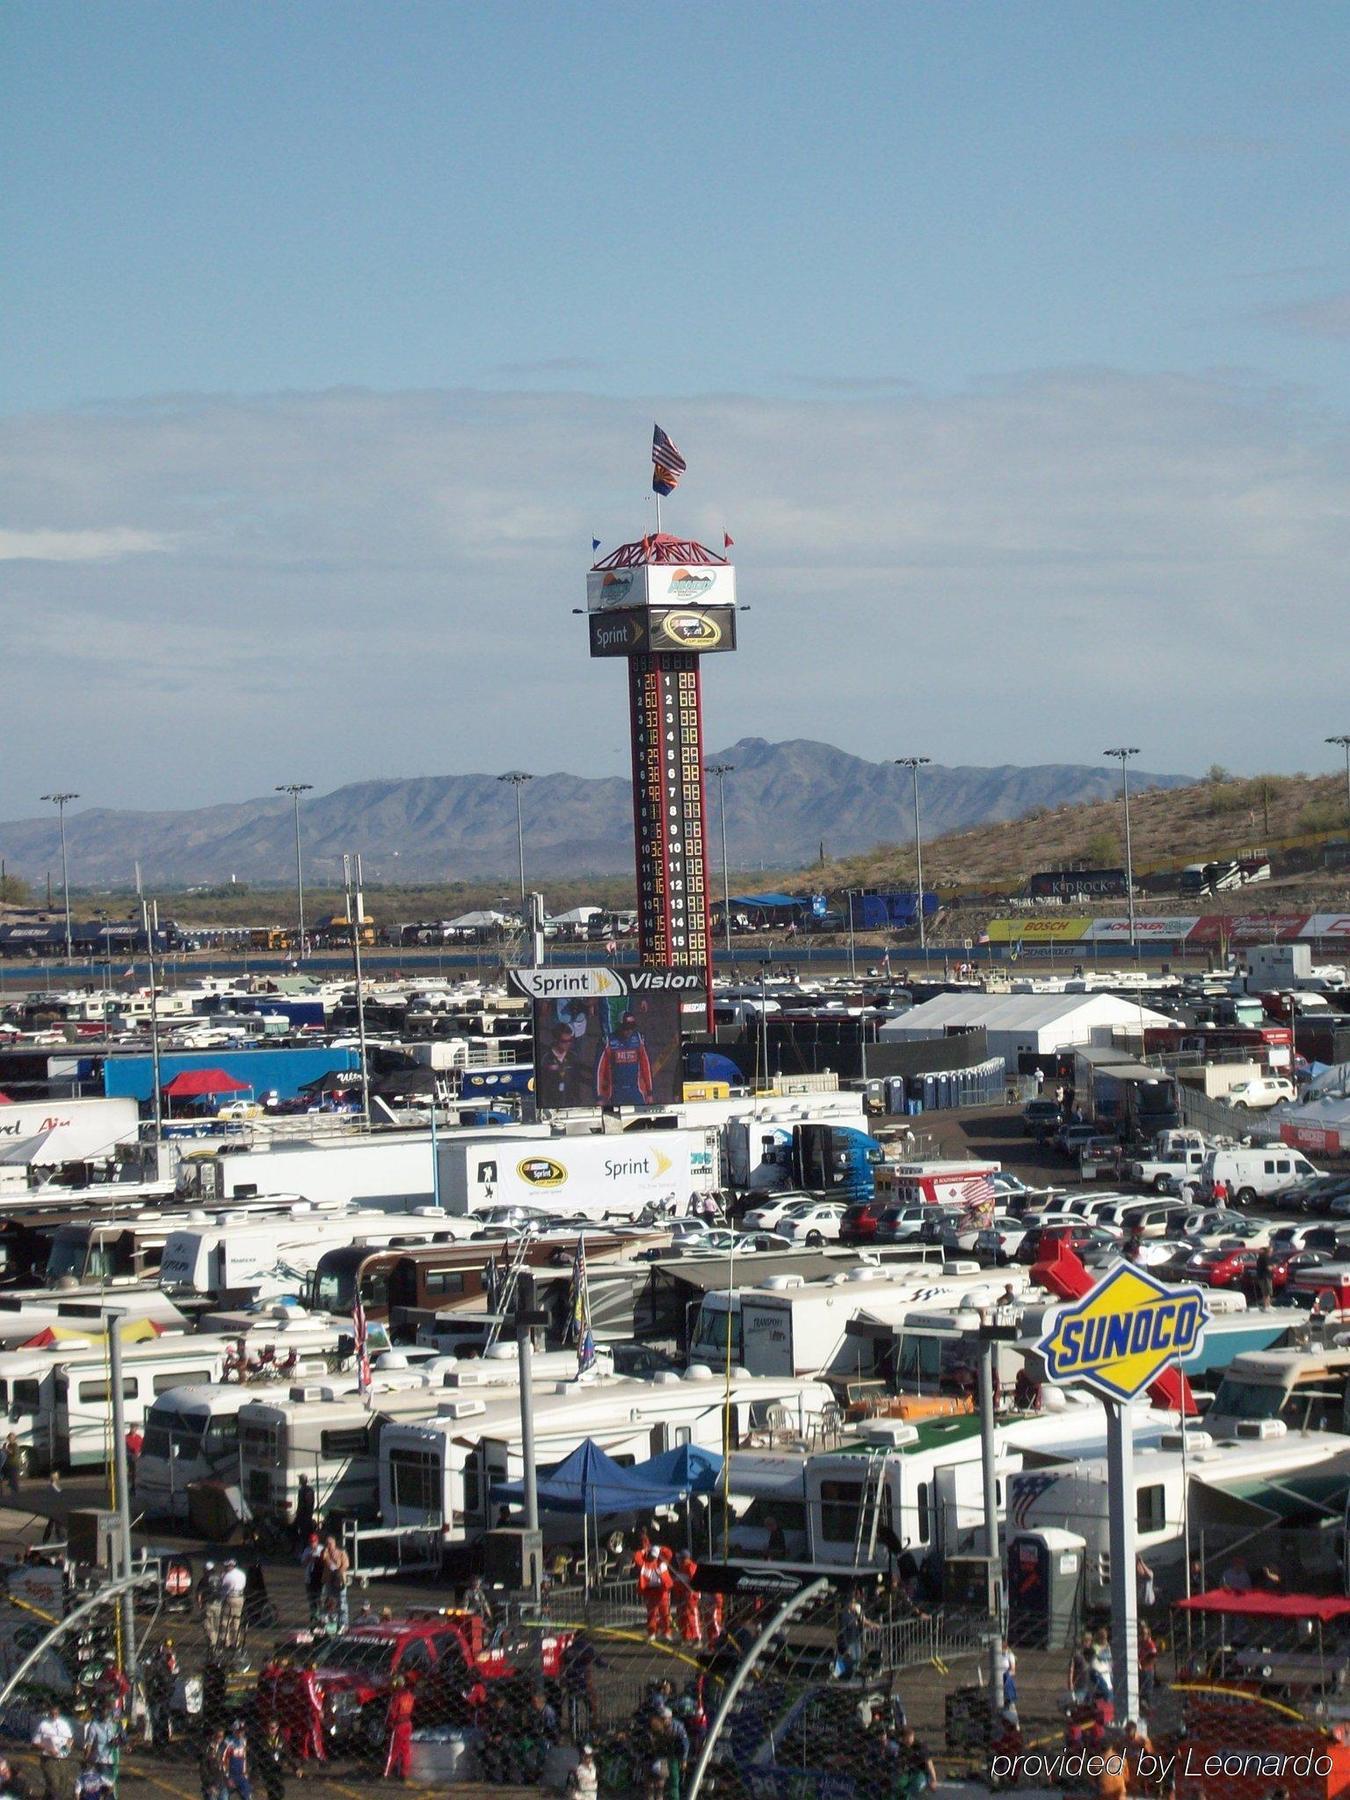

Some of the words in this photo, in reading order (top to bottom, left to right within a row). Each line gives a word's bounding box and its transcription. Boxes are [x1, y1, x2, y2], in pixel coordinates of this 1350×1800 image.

[596, 626, 628, 649] Sprint
[637, 679, 641, 688] 1
[664, 676, 671, 686] 1
[637, 697, 643, 706] 2
[665, 694, 673, 705] 2
[638, 715, 644, 724] 3
[666, 712, 674, 723] 3
[639, 733, 644, 743] 4
[666, 731, 675, 741] 4
[639, 752, 645, 761] 5
[667, 749, 675, 760] 5
[667, 768, 676, 779] 6
[641, 789, 646, 799] 7
[668, 787, 676, 797] 7
[669, 806, 677, 816] 8
[642, 826, 648, 836] 9
[670, 824, 678, 835] 9
[641, 845, 650, 855] 10
[668, 842, 681, 853] 10
[641, 864, 651, 873] 11
[668, 861, 681, 872] 11
[642, 882, 652, 891] 12
[669, 879, 683, 890] 12
[1076, 880, 1108, 893] ROCK
[643, 901, 652, 910] 13
[670, 898, 683, 909] 13
[644, 919, 653, 928] 14
[671, 917, 684, 928] 14
[1023, 921, 1070, 931] BOSCH
[1111, 922, 1163, 930] CHCKER
[671, 936, 685, 947] 15
[533, 974, 589, 995] Sprint
[629, 972, 698, 989] Vision
[604, 1158, 650, 1181] Sprint
[1057, 1301, 1198, 1368] SUNOCO
